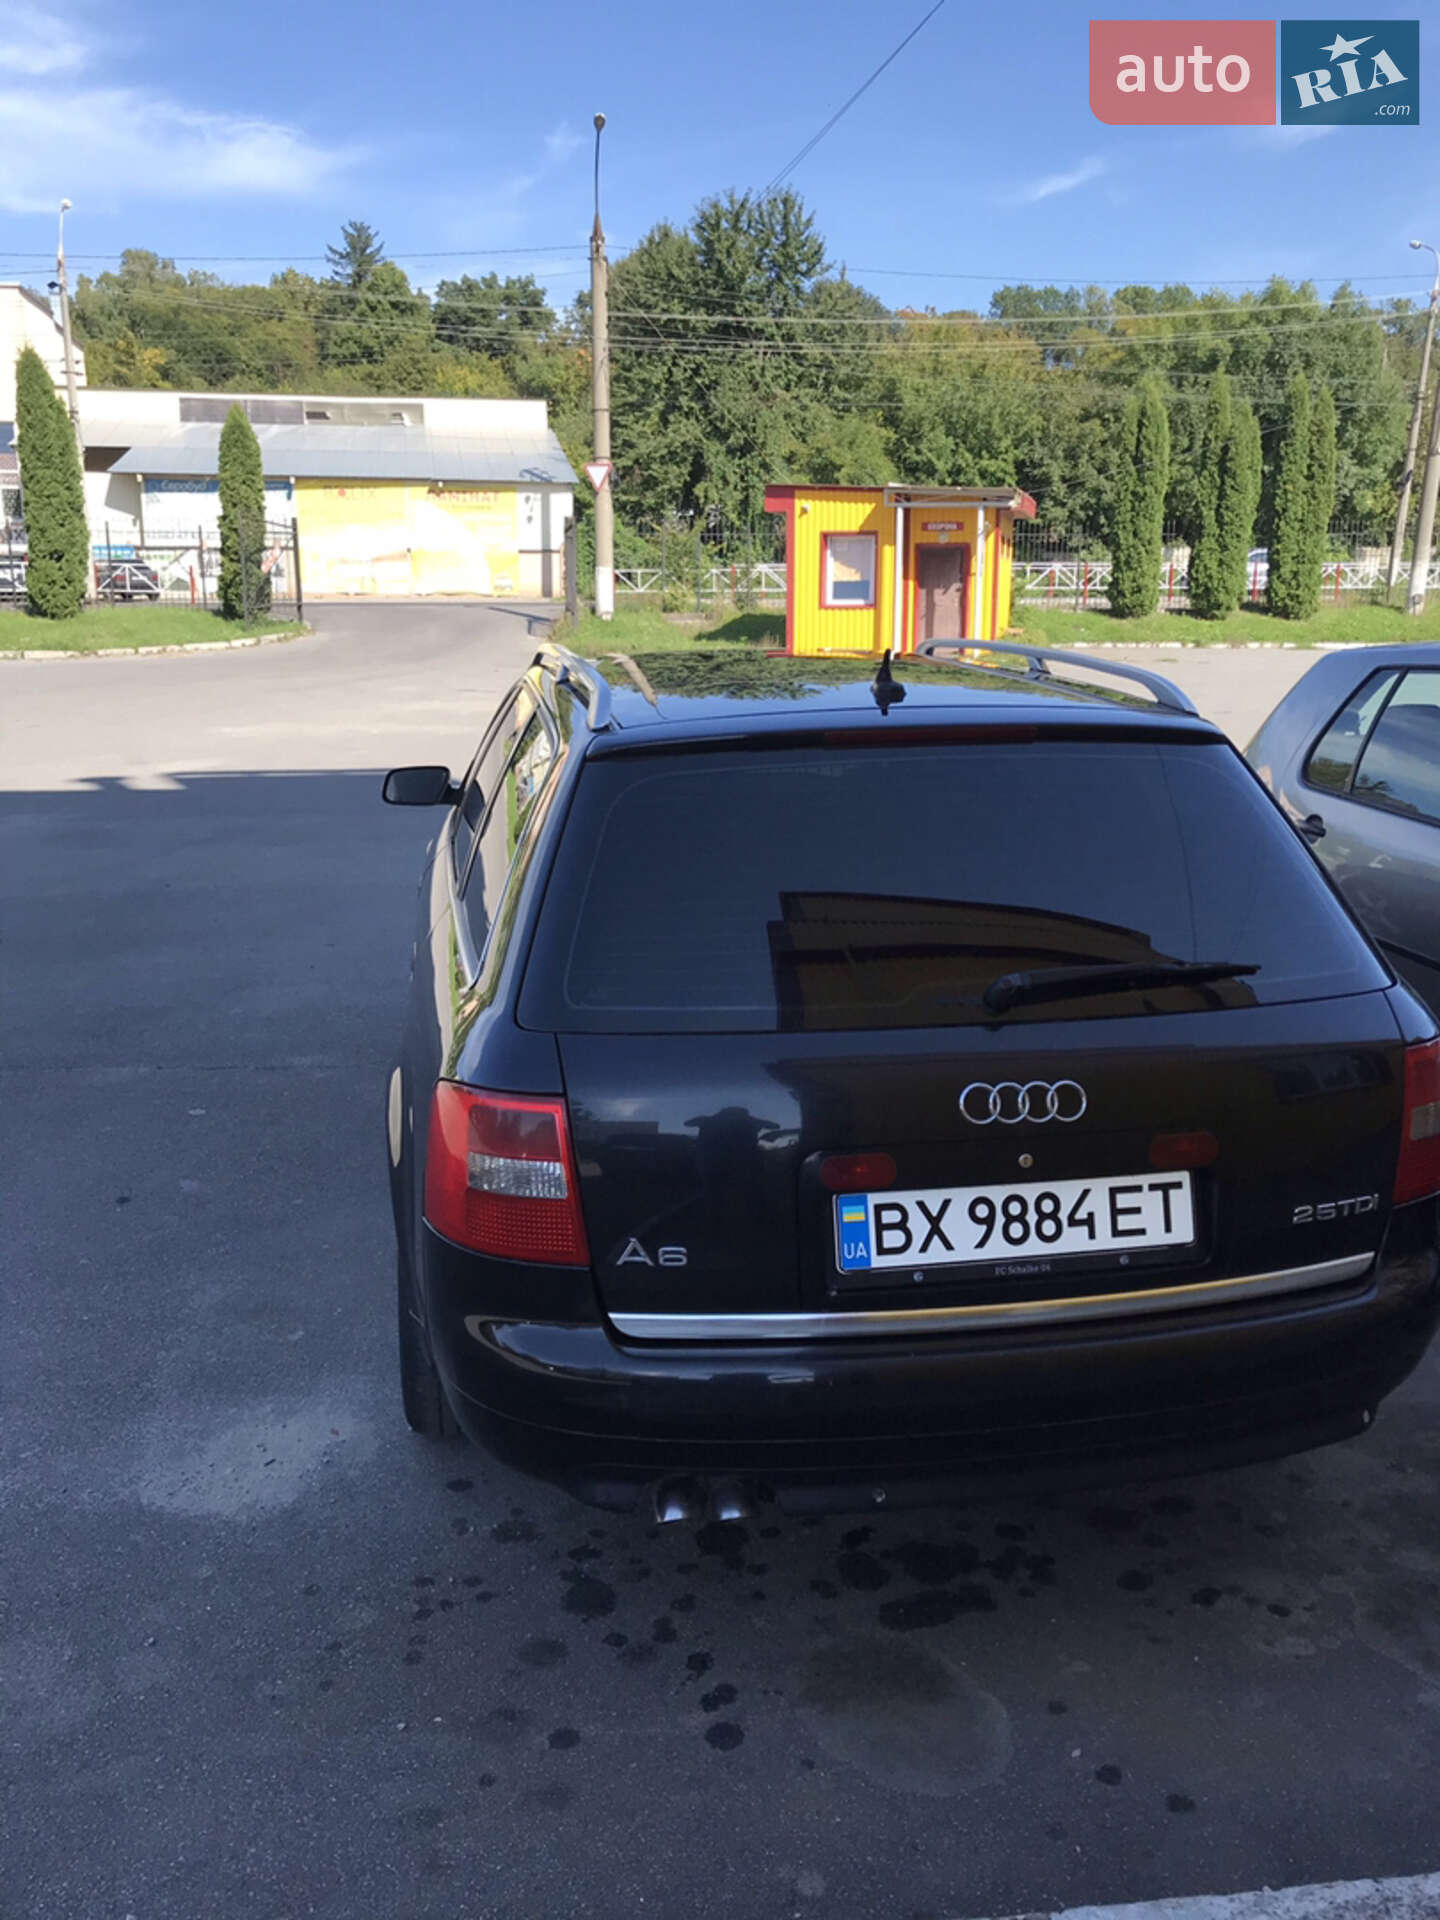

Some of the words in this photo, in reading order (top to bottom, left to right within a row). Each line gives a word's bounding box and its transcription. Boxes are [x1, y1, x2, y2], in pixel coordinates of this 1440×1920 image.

[873, 1198, 955, 1257] BX
[968, 1188, 1098, 1250] 9884
[1107, 1180, 1184, 1239] ET
[615, 1237, 689, 1268] A6
[843, 1241, 869, 1260] UA
